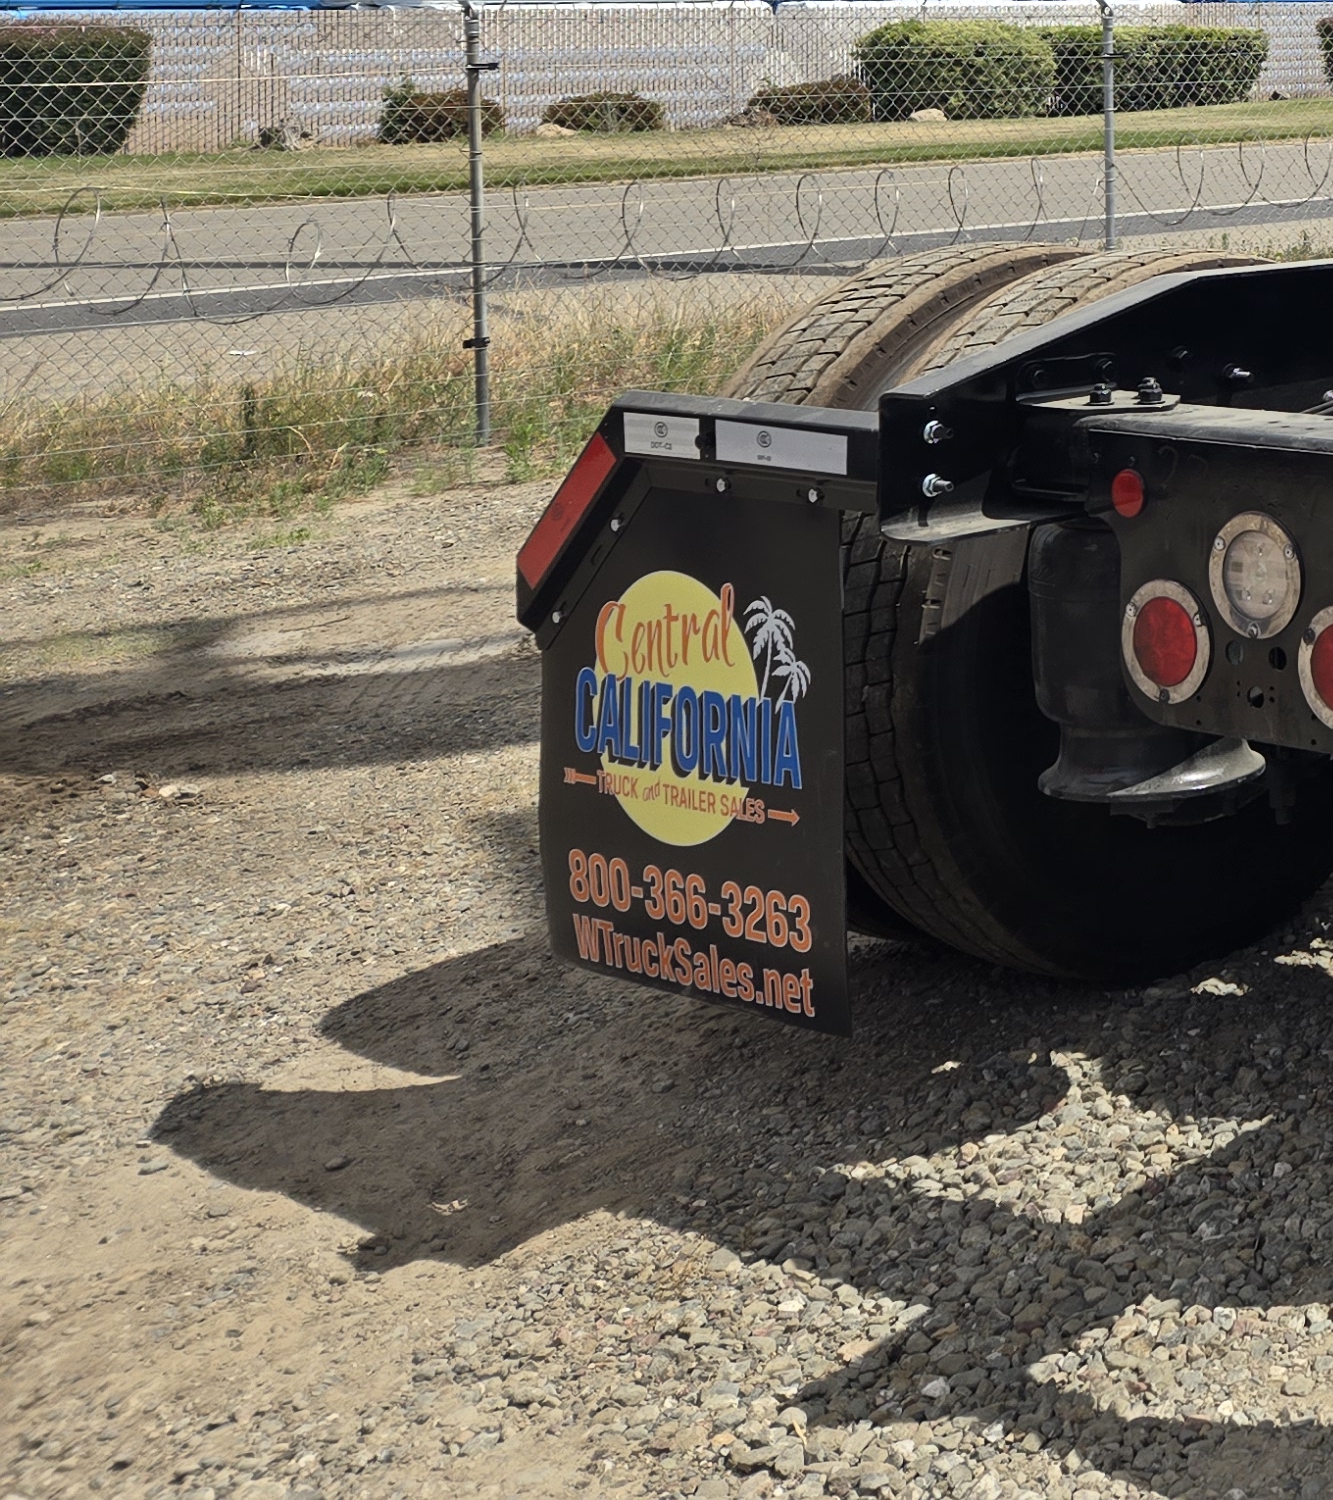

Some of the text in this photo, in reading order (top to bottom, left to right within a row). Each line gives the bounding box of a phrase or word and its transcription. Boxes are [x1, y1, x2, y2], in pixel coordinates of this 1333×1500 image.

[595, 582, 736, 682] Central
[575, 666, 803, 790] CALIFORNIA
[596, 769, 766, 825] TRUCK and TRAILER SALES
[568, 848, 813, 953] 800-366-3263
[572, 913, 816, 1018] WTruckSales.net
